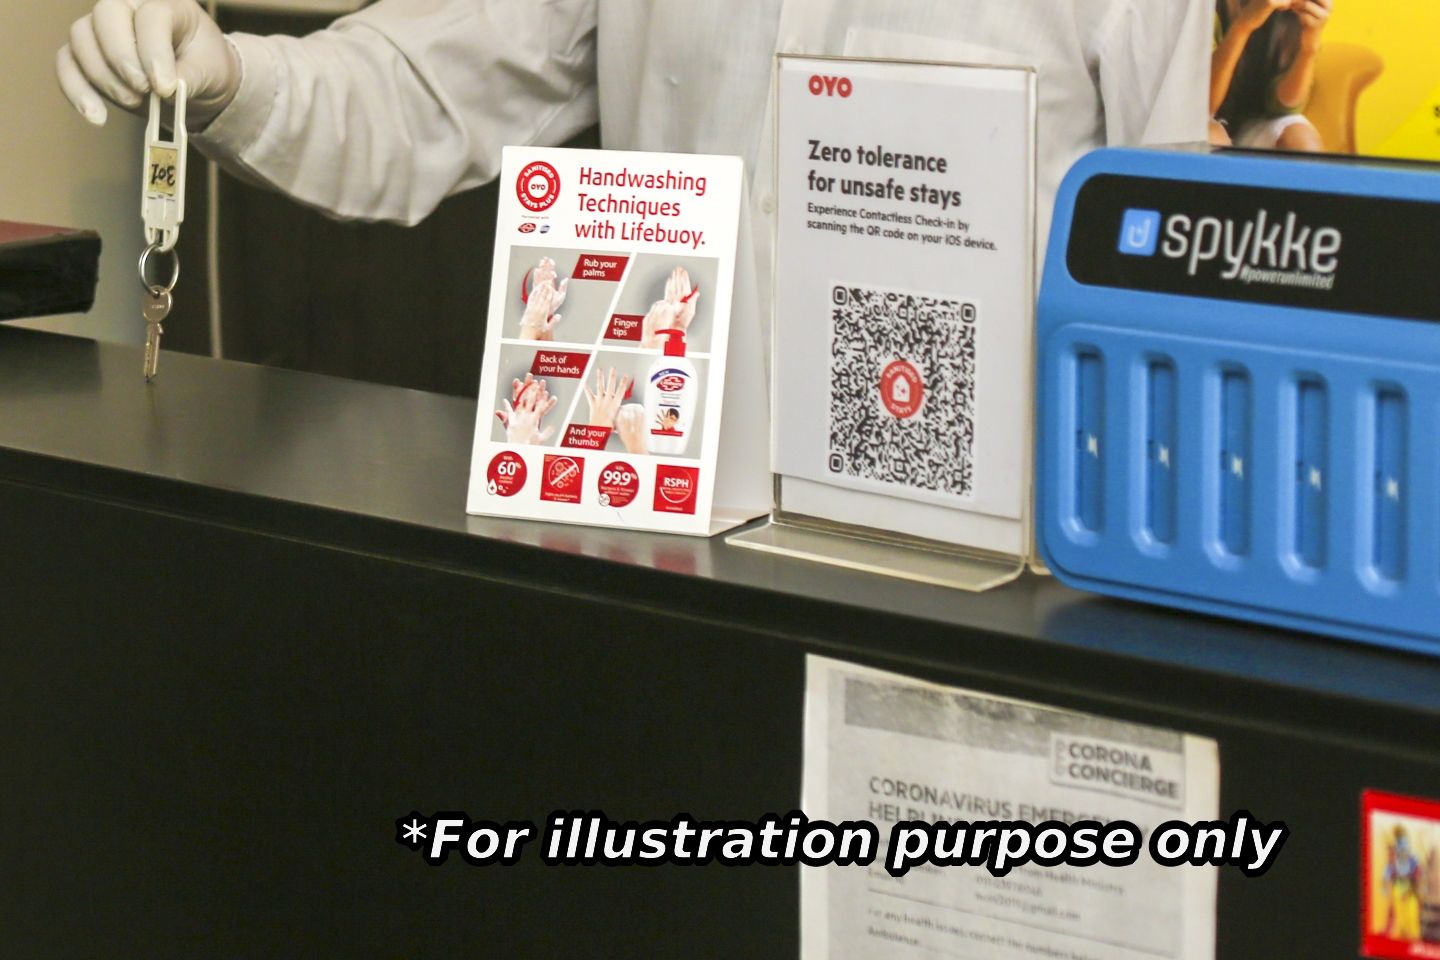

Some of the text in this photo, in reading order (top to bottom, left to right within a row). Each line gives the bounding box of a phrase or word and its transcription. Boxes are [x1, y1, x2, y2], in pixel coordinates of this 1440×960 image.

[808, 75, 853, 98] OYO
[808, 139, 947, 173] Zero tolerance
[579, 167, 707, 196] Handwashing
[807, 169, 962, 210] for unsafe stays
[578, 193, 681, 219] Techniques
[807, 203, 970, 232] Experience Contactless Check-in by
[575, 220, 615, 239] with
[621, 222, 705, 250] Lifebuoy.
[807, 219, 848, 235] scanning
[849, 222, 864, 234] the
[866, 225, 881, 236] QR
[883, 227, 905, 239] code
[907, 231, 919, 241] on
[921, 234, 942, 245] your
[964, 237, 998, 251] device.
[1162, 208, 1342, 279] spykke
[582, 269, 605, 277] palms
[584, 258, 617, 270] Rub your
[1239, 264, 1335, 289] #powerunlimited
[613, 328, 627, 337] tips
[614, 318, 638, 328] Finger
[539, 365, 579, 374] your hands
[540, 355, 567, 364] Back of
[568, 437, 599, 447] thumbs
[569, 427, 606, 438] And your
[663, 477, 689, 488] RSPH
[1069, 743, 1153, 772] CORONA
[1068, 763, 1179, 799] CONCIERGE
[869, 776, 1013, 819] CORONAVIRUS
